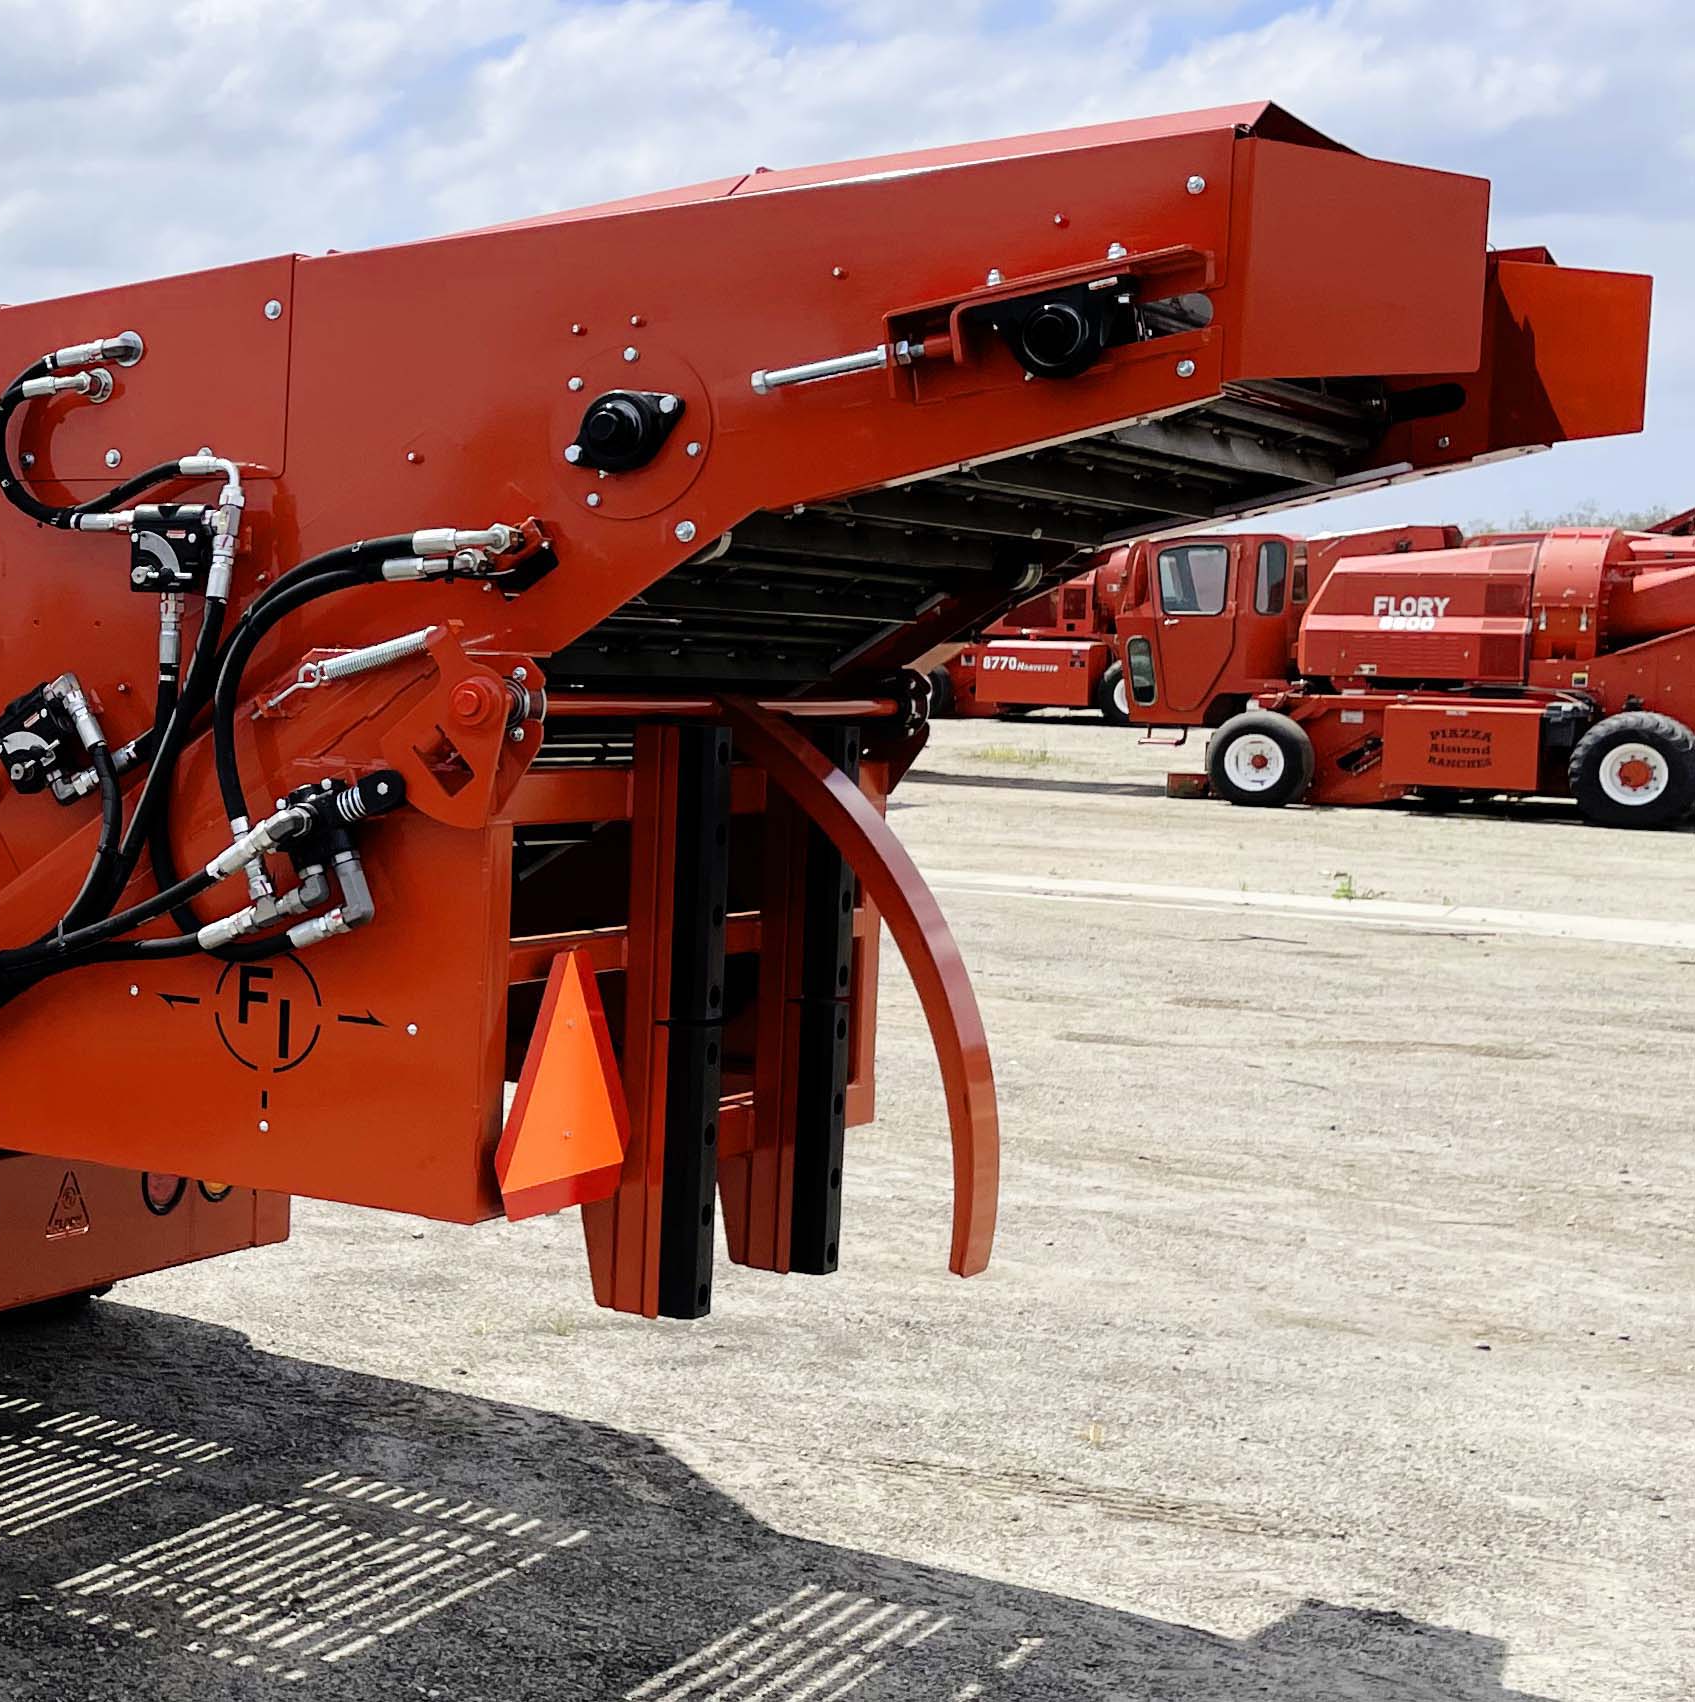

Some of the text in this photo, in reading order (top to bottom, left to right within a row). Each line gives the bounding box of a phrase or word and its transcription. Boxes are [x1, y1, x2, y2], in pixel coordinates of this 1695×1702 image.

[1373, 595, 1450, 617] FLORY
[982, 655, 1017, 671] 8770
[1429, 729, 1493, 742] PIAZZA
